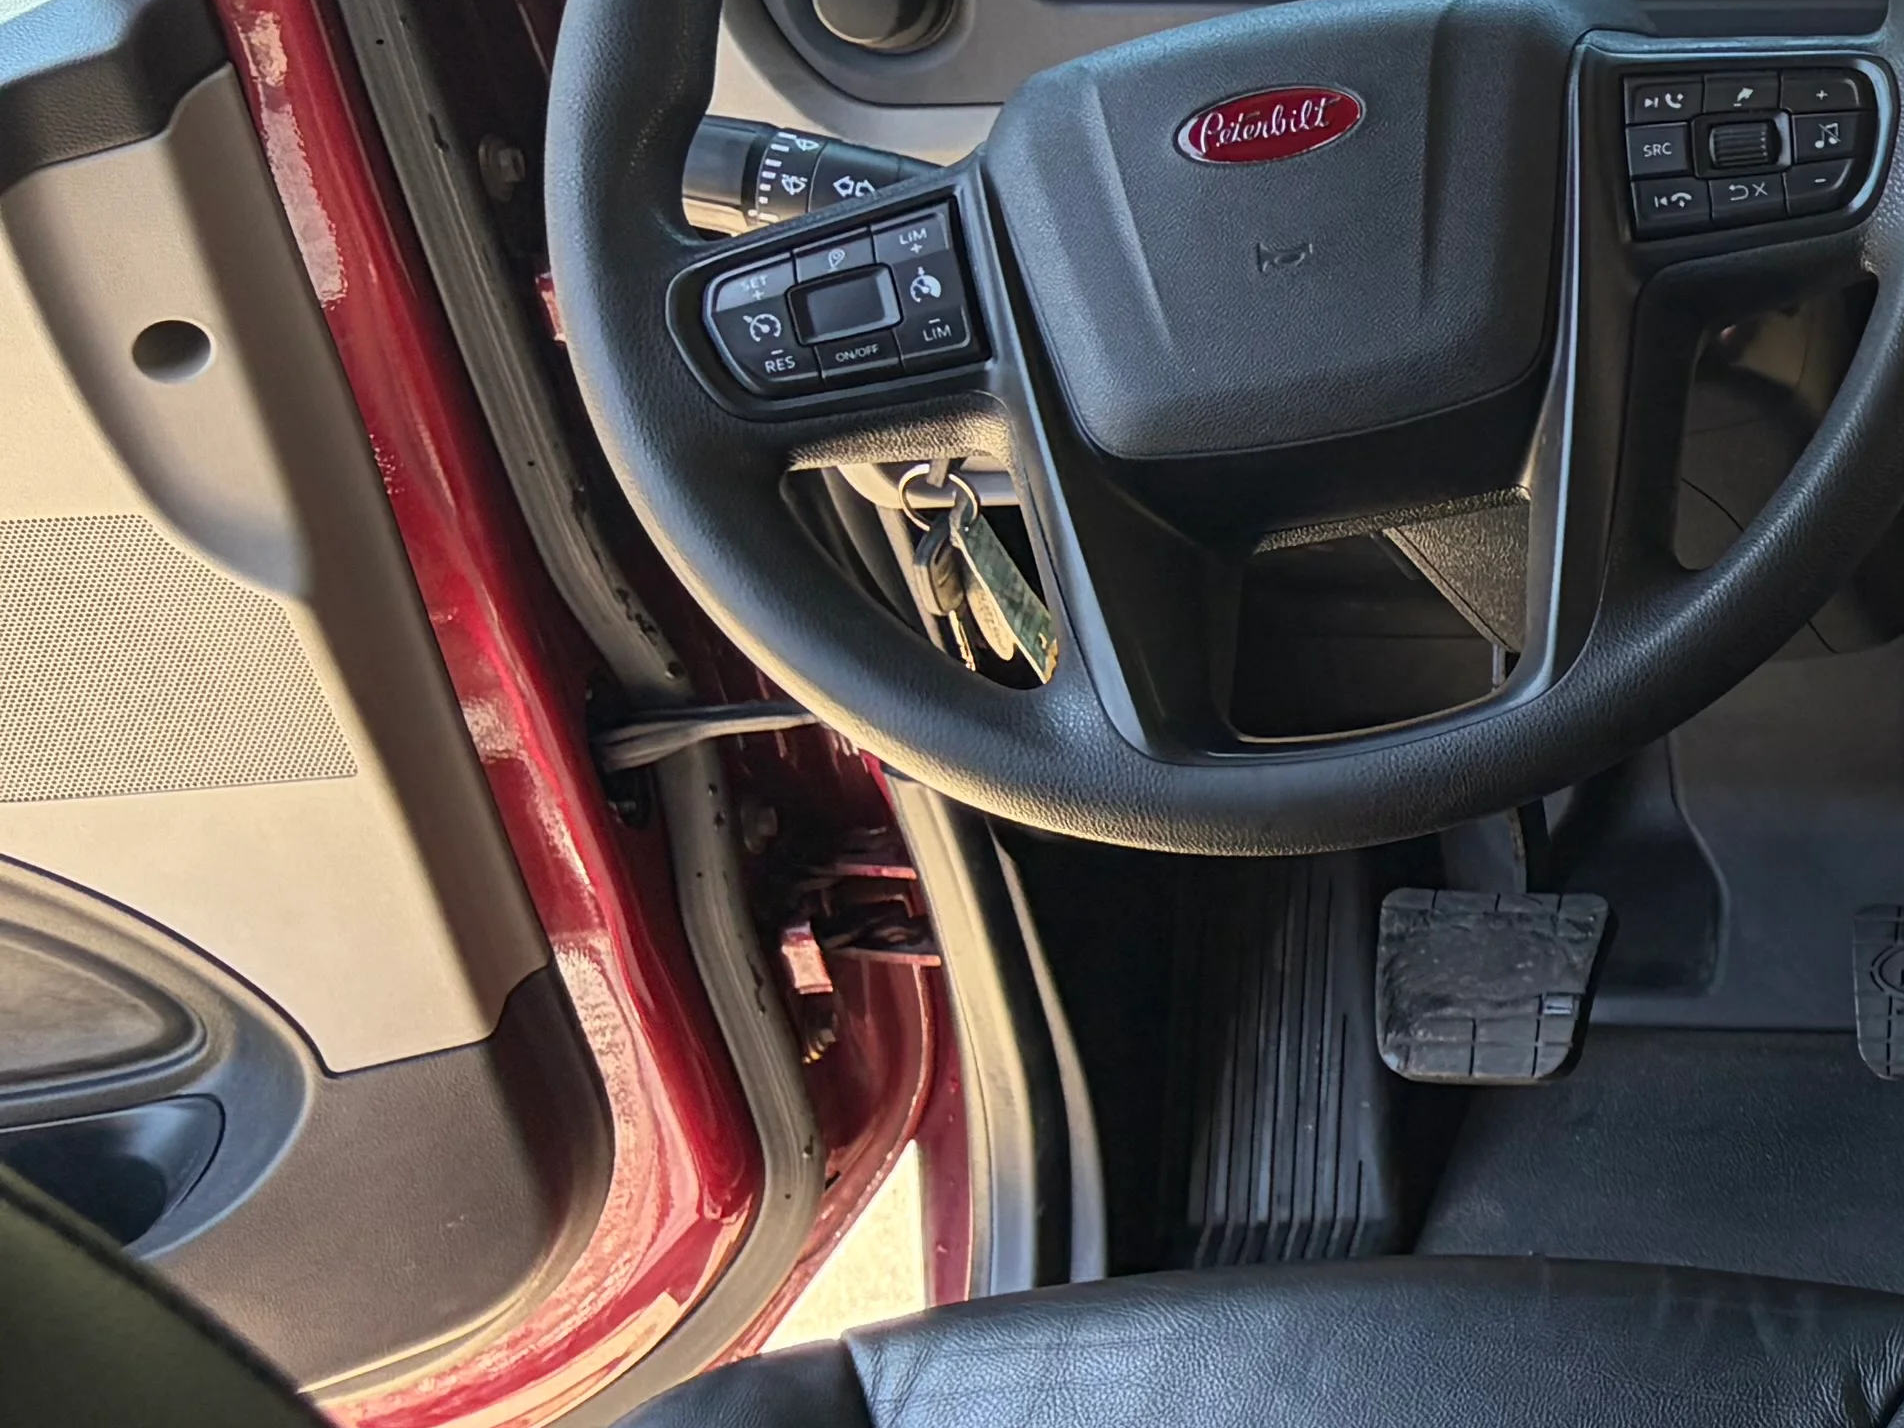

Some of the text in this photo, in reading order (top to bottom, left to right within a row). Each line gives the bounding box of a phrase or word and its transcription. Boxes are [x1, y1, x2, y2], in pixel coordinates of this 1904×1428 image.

[1200, 97, 1343, 153] Peterbilt
[1643, 142, 1672, 157] SRC
[899, 228, 928, 247] LIM
[740, 274, 768, 292] SET
[923, 324, 951, 342] LIM
[835, 343, 880, 363] ON/OFF
[765, 356, 796, 374] RES
